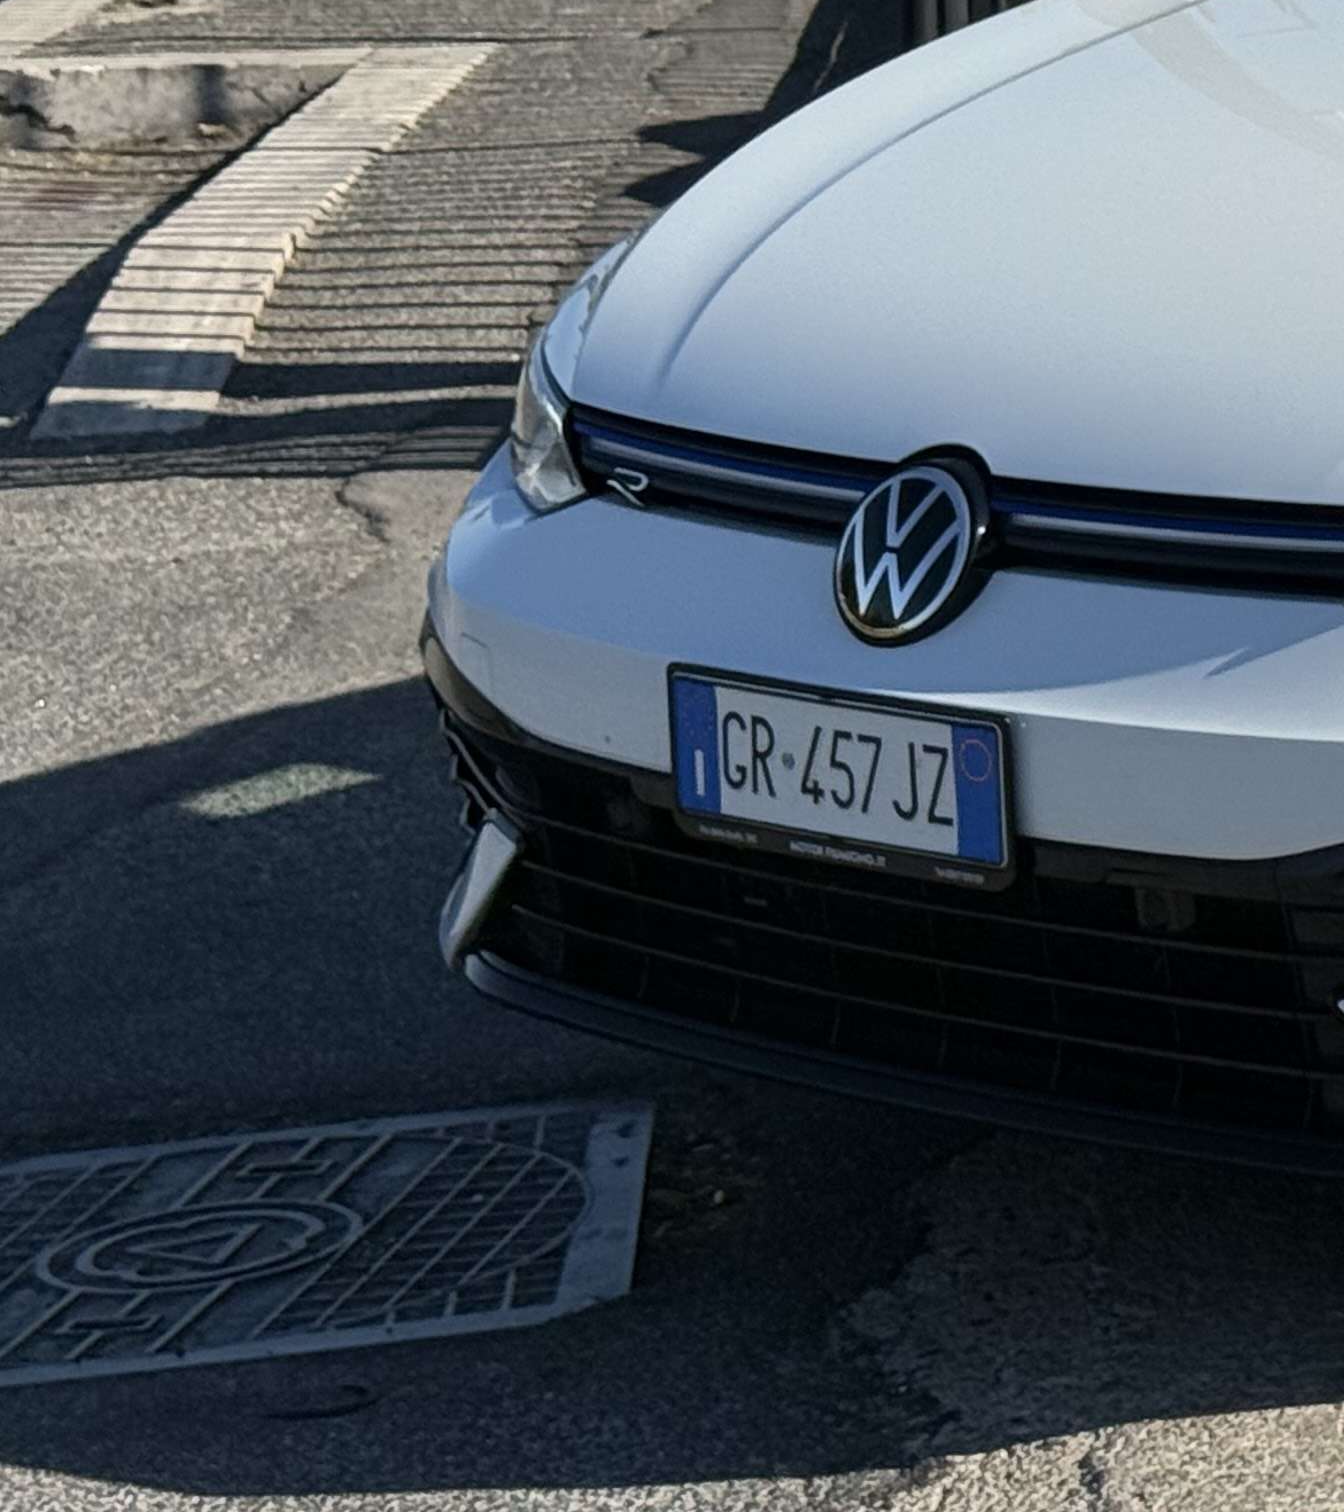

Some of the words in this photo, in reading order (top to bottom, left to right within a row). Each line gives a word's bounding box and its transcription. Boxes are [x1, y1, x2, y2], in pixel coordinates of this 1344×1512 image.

[720, 710, 777, 798] GR
[800, 724, 883, 815] 457
[892, 740, 955, 827] JZ
